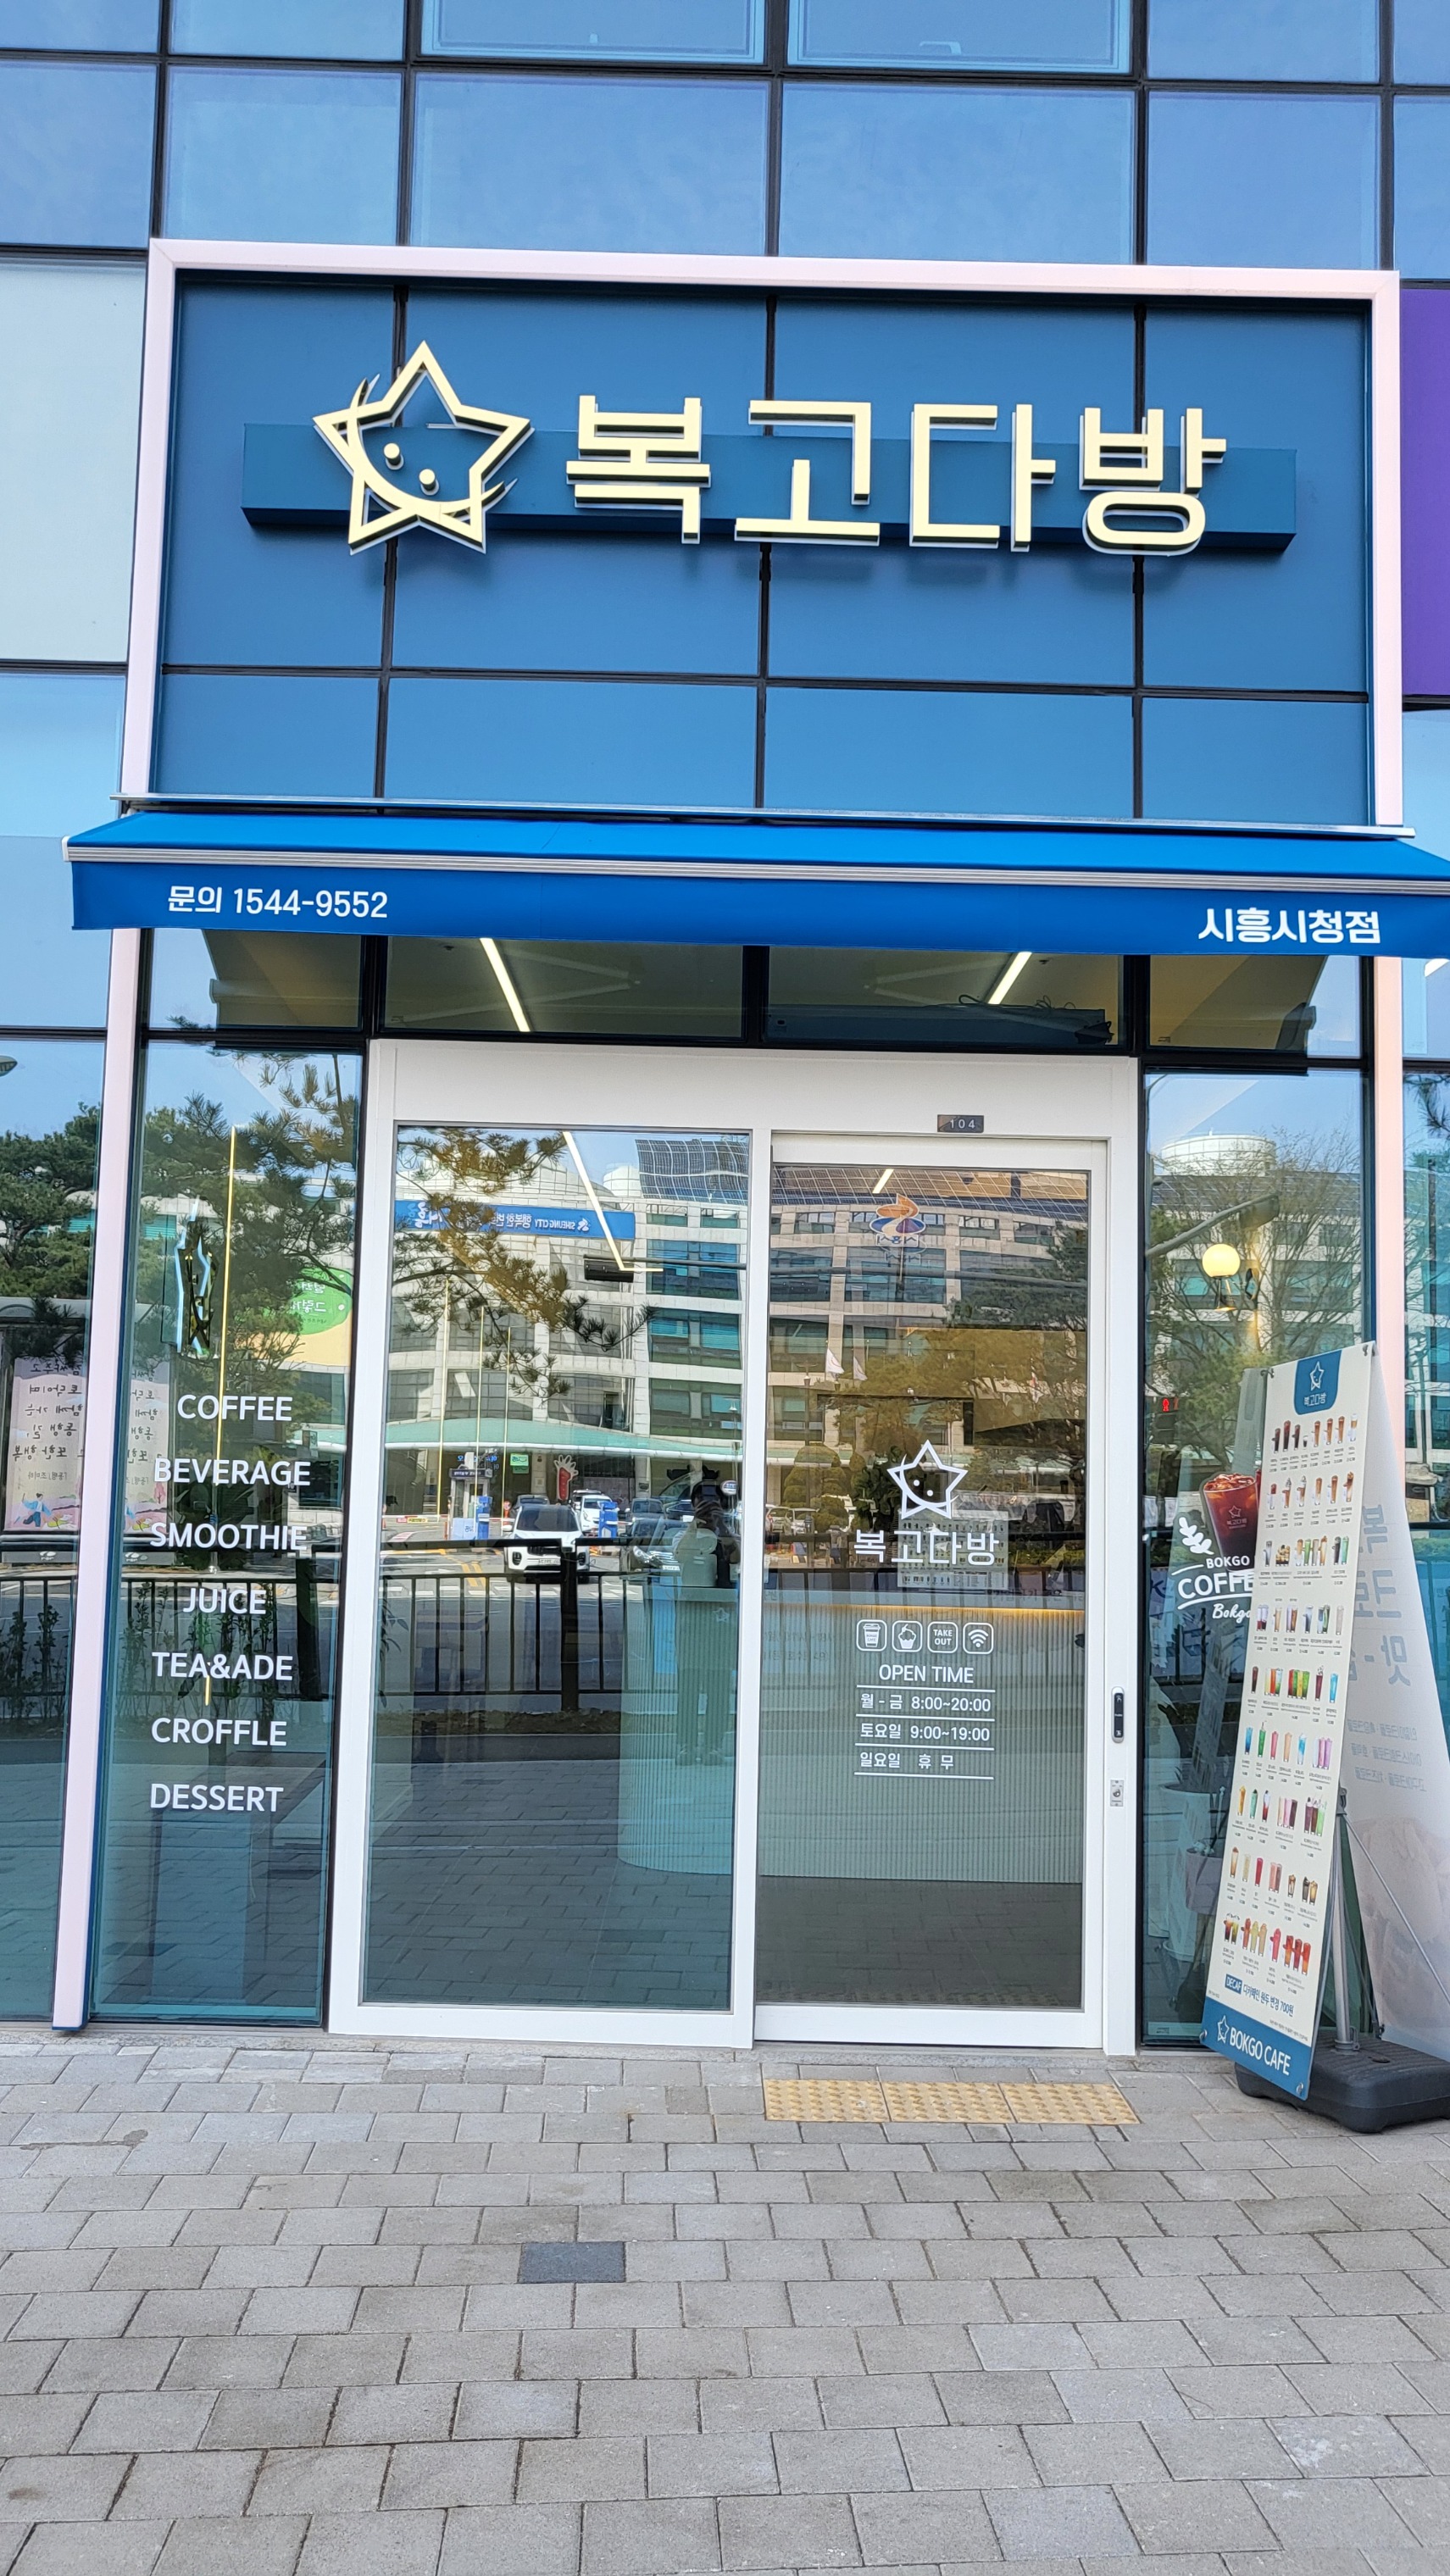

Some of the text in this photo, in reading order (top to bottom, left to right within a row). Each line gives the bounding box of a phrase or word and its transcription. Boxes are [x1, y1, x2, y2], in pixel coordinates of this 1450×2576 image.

[564, 391, 1228, 558] 복고다방
[168, 886, 388, 918] 문의 1544-9552
[1197, 907, 1381, 944] 시흥시청점
[949, 1119, 975, 1129] 104
[177, 1394, 293, 1421] COFFEE
[154, 1457, 311, 1486] BEVERAGE
[150, 1523, 308, 1551] SMOOTHIE
[853, 1529, 1000, 1566] 복고다방
[1206, 1556, 1250, 1568] BOKGO
[183, 1587, 266, 1614] JUICE
[933, 1629, 953, 1637] TAKE
[934, 1637, 953, 1646] OUT
[152, 1652, 293, 1680] TEA&ADE
[879, 1664, 975, 1684] OPEN TIME
[911, 1696, 991, 1712] 8:00~20:00
[151, 1718, 287, 1746] CROFFLE
[860, 1723, 990, 1741] 토요일 9:00~19:00
[860, 1752, 901, 1768] 일요일
[150, 1783, 284, 1812] DESSERT
[1226, 1974, 1242, 1993] DECAF
[1229, 2027, 1263, 2060] BOKGO
[1264, 2045, 1292, 2076] CAFE
